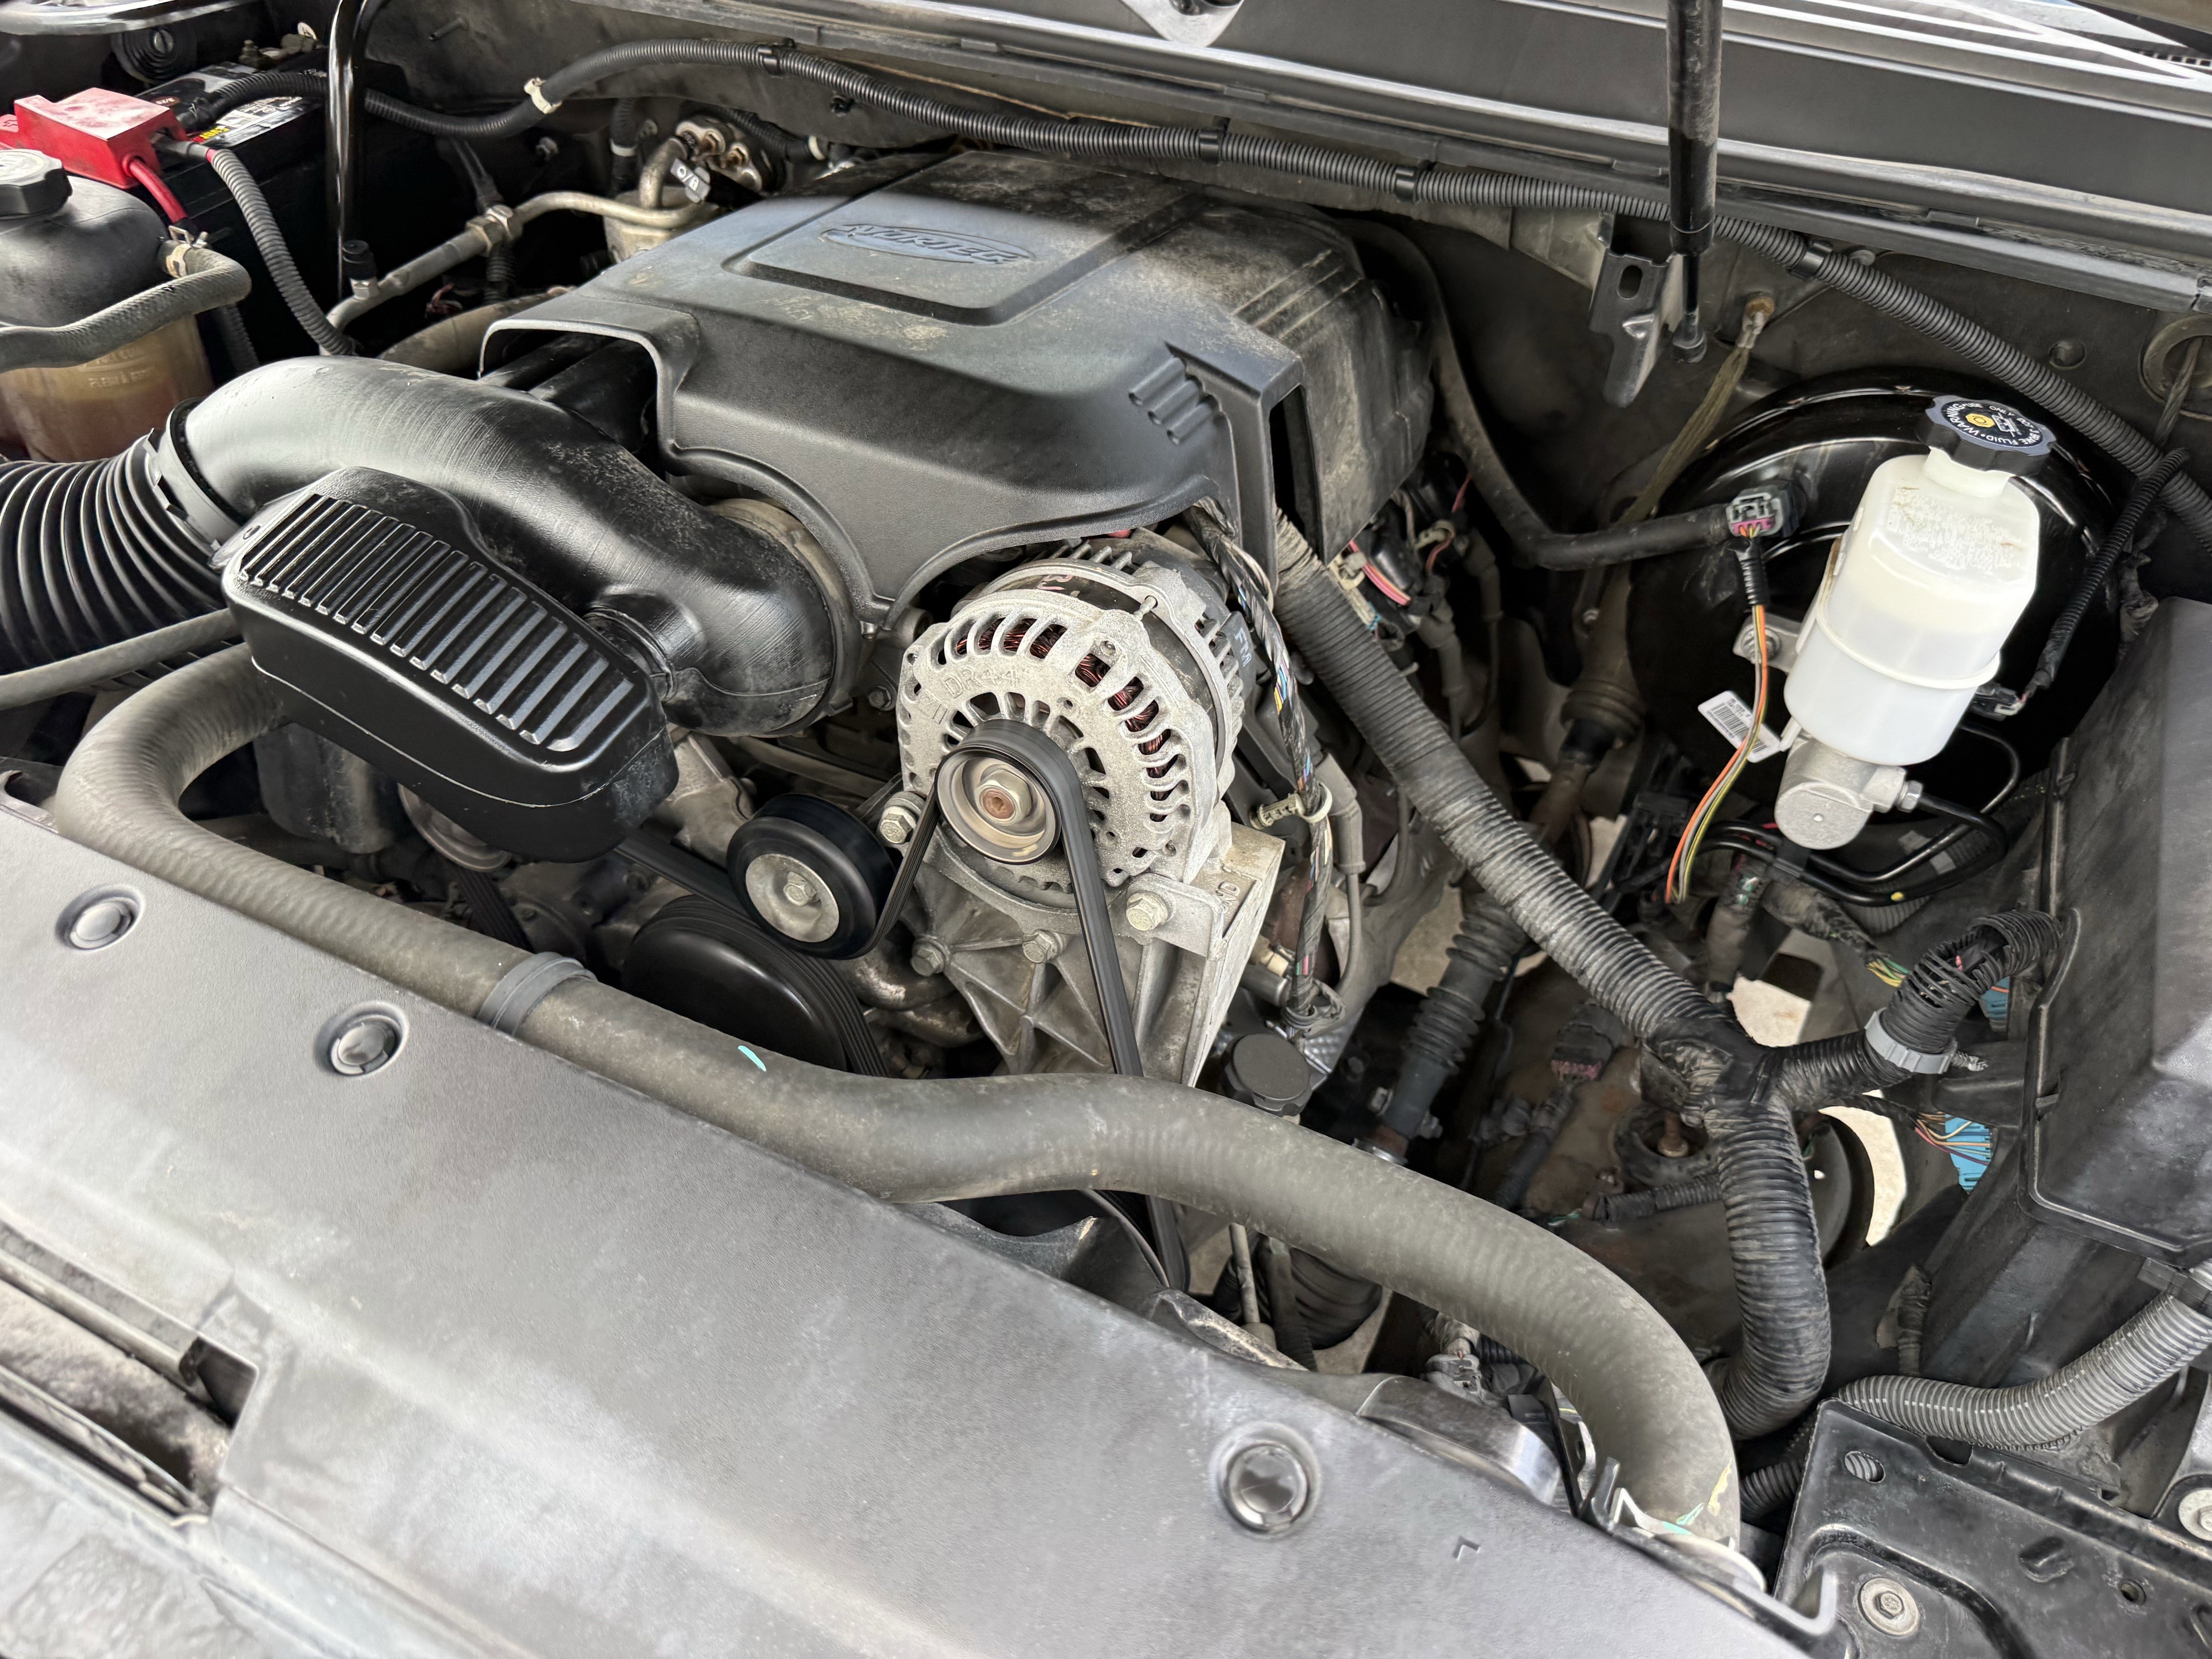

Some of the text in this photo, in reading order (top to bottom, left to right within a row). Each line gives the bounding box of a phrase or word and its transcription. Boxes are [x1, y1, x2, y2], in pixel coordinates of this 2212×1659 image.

[848, 226, 1020, 264] VORTEC
[1946, 404, 1979, 435] WARNING
[1986, 435, 2018, 445] FLUID
